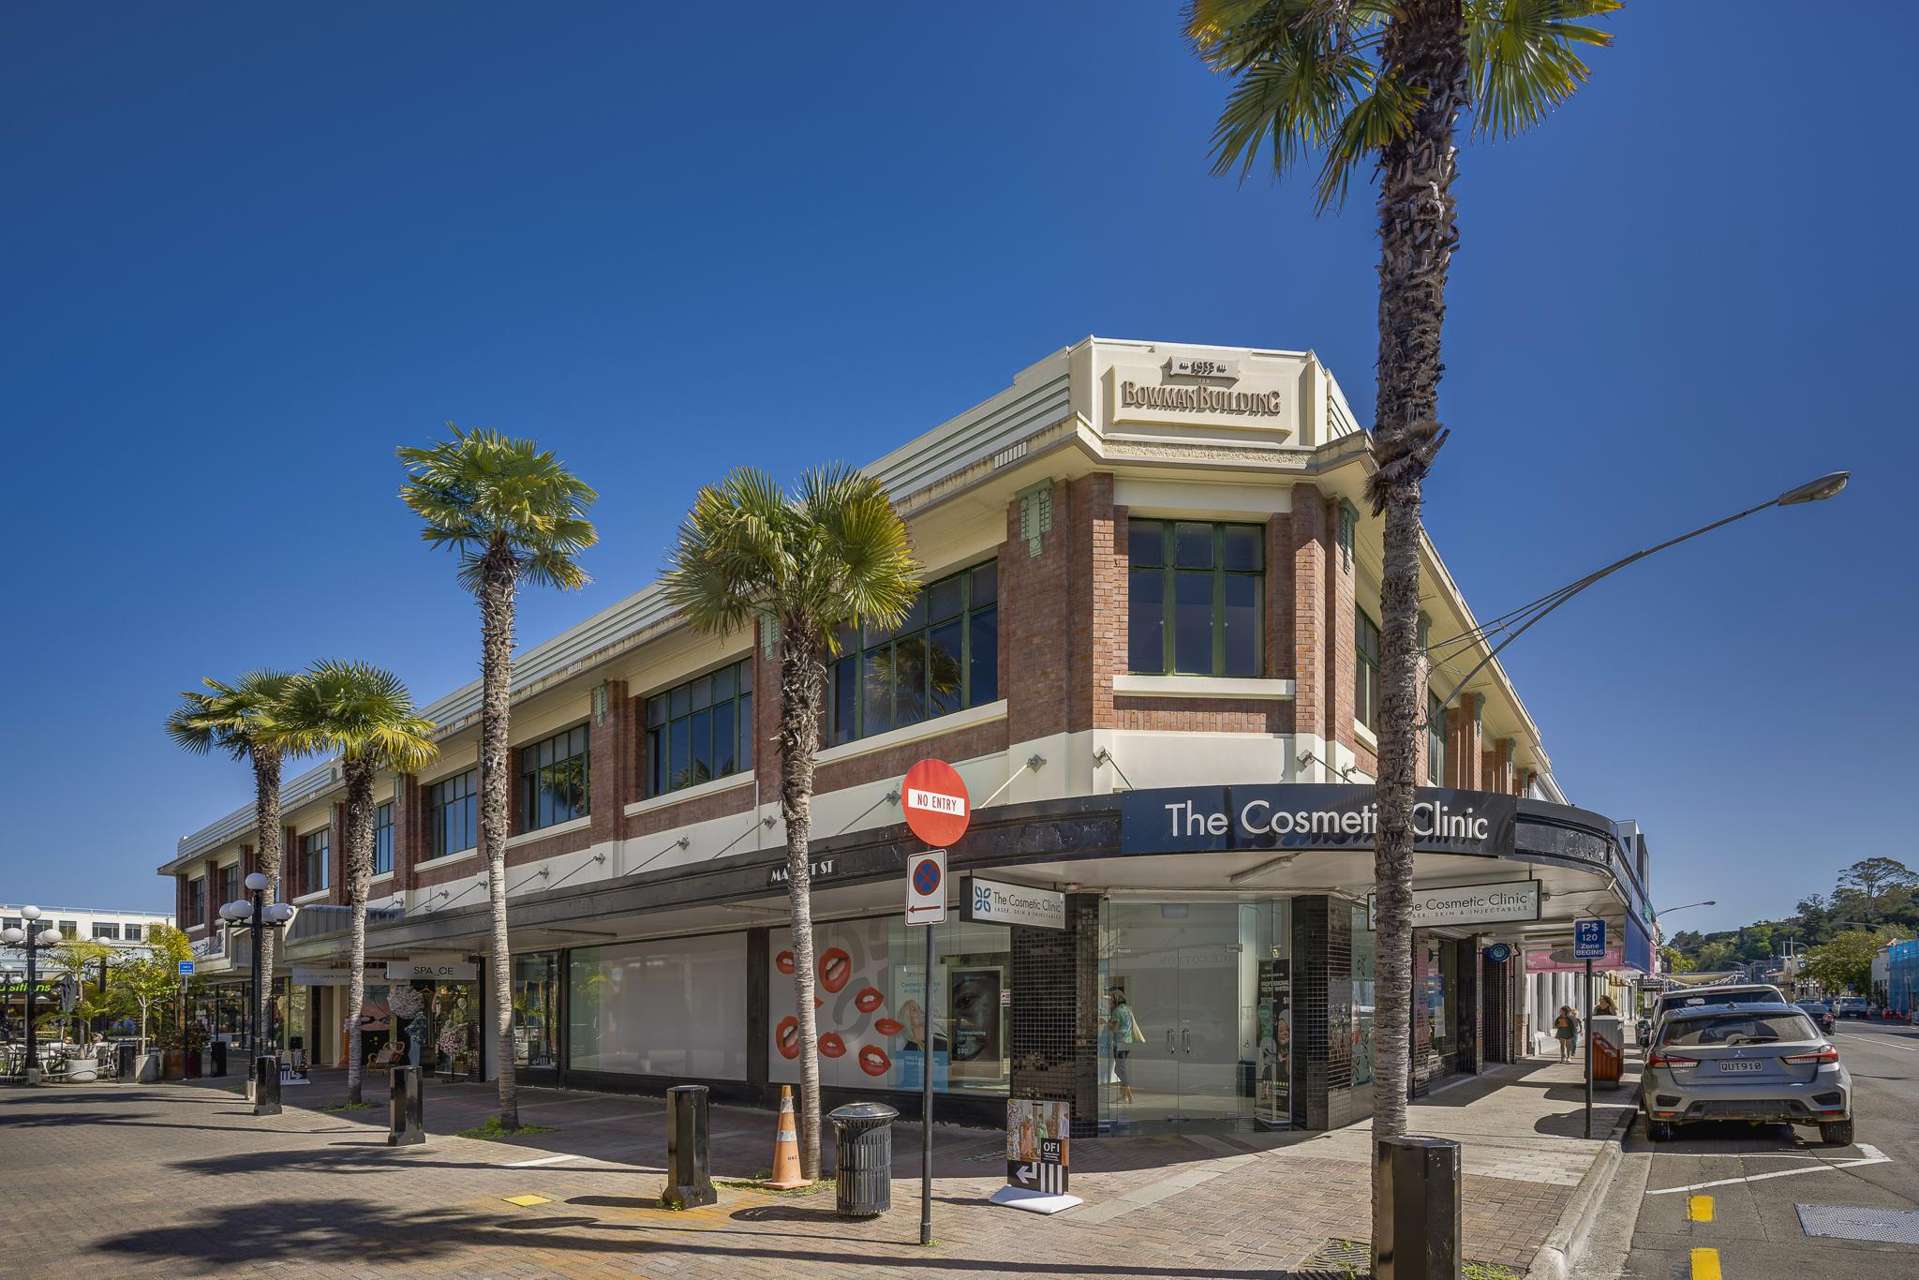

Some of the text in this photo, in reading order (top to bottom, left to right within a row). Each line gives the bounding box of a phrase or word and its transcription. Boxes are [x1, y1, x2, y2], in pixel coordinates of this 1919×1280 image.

[1120, 381, 1281, 416] BOWMAN BUILDING
[917, 793, 957, 812] NO ENTRY
[1165, 800, 1488, 839] The Cosmeti Clinic
[820, 860, 835, 874] ST
[993, 891, 1062, 913] The Cosmetic Clinic
[1426, 896, 1484, 911] Cosmetic
[1488, 892, 1528, 906] Clinic
[1582, 934, 1598, 942] 120
[1043, 1141, 1060, 1152] OFI
